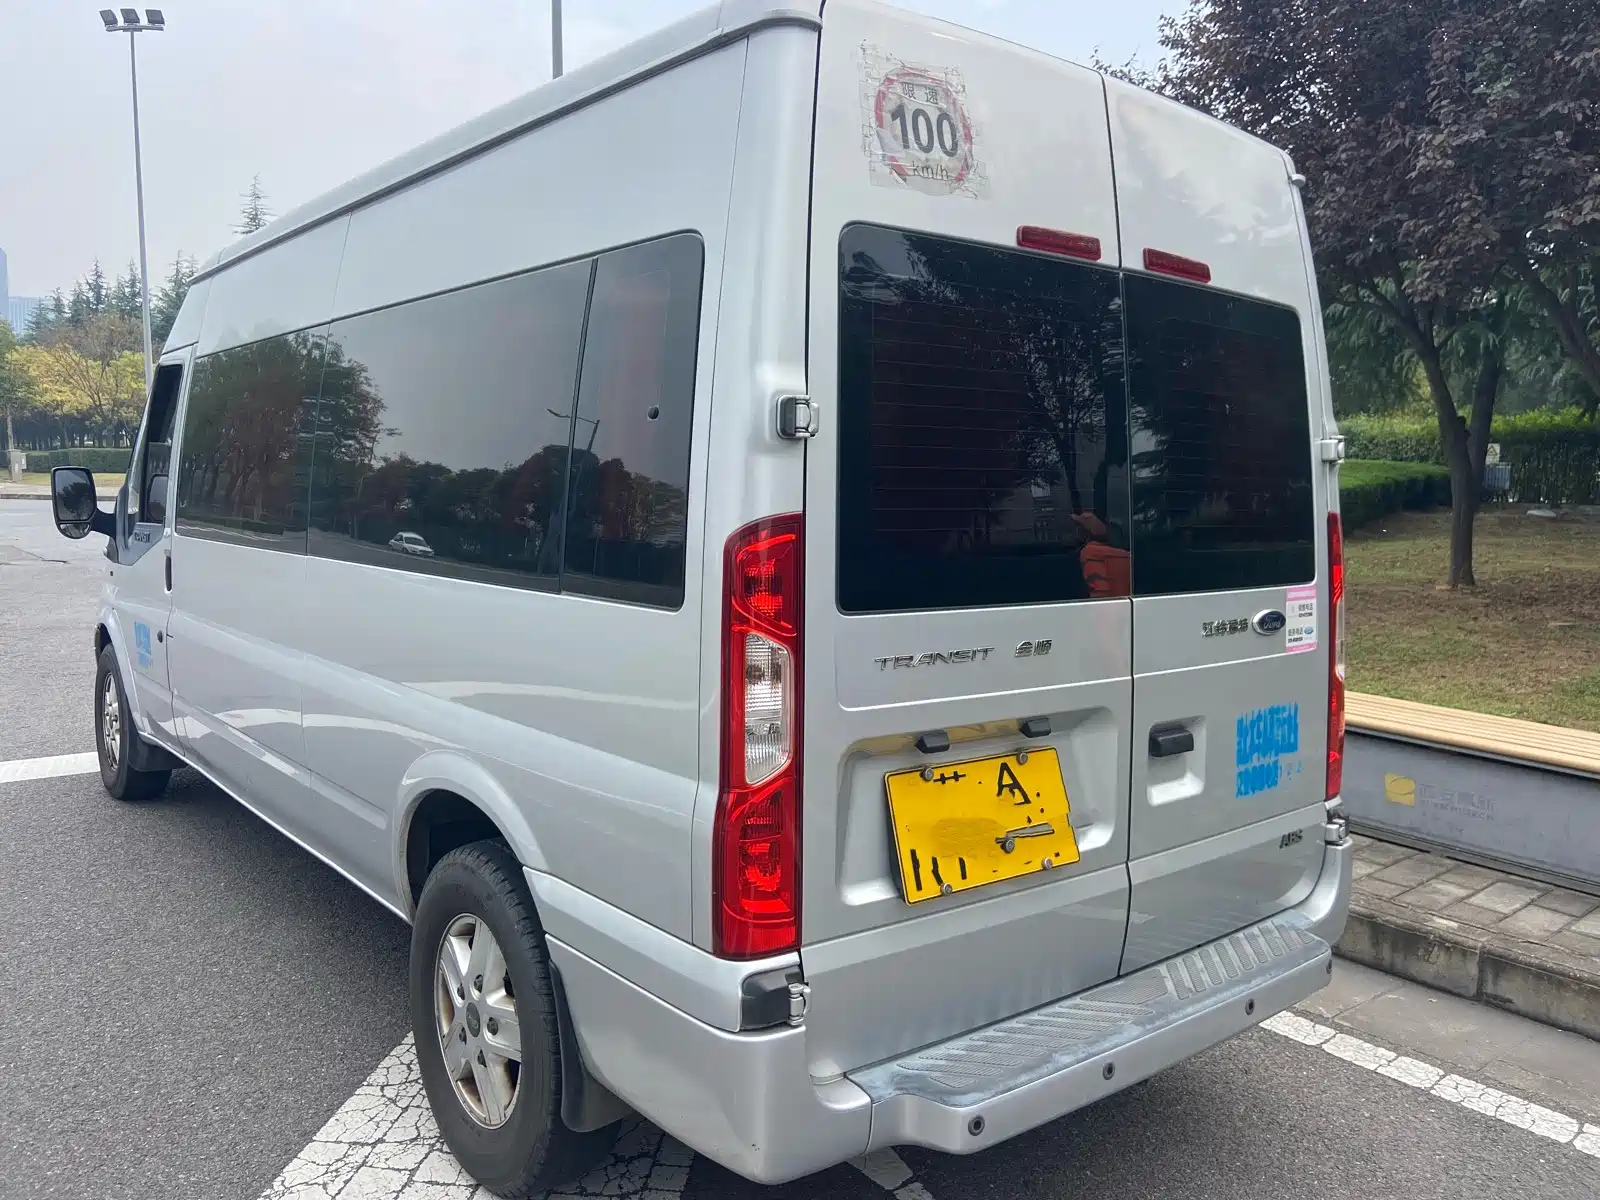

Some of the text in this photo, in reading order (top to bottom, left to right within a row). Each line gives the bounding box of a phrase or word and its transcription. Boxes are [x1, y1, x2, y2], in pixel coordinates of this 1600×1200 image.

[901, 82, 939, 105] 限速
[891, 104, 959, 157] 100
[911, 161, 950, 180] km/h
[874, 646, 995, 671] TRANSIT
[1279, 828, 1304, 849] ABS
